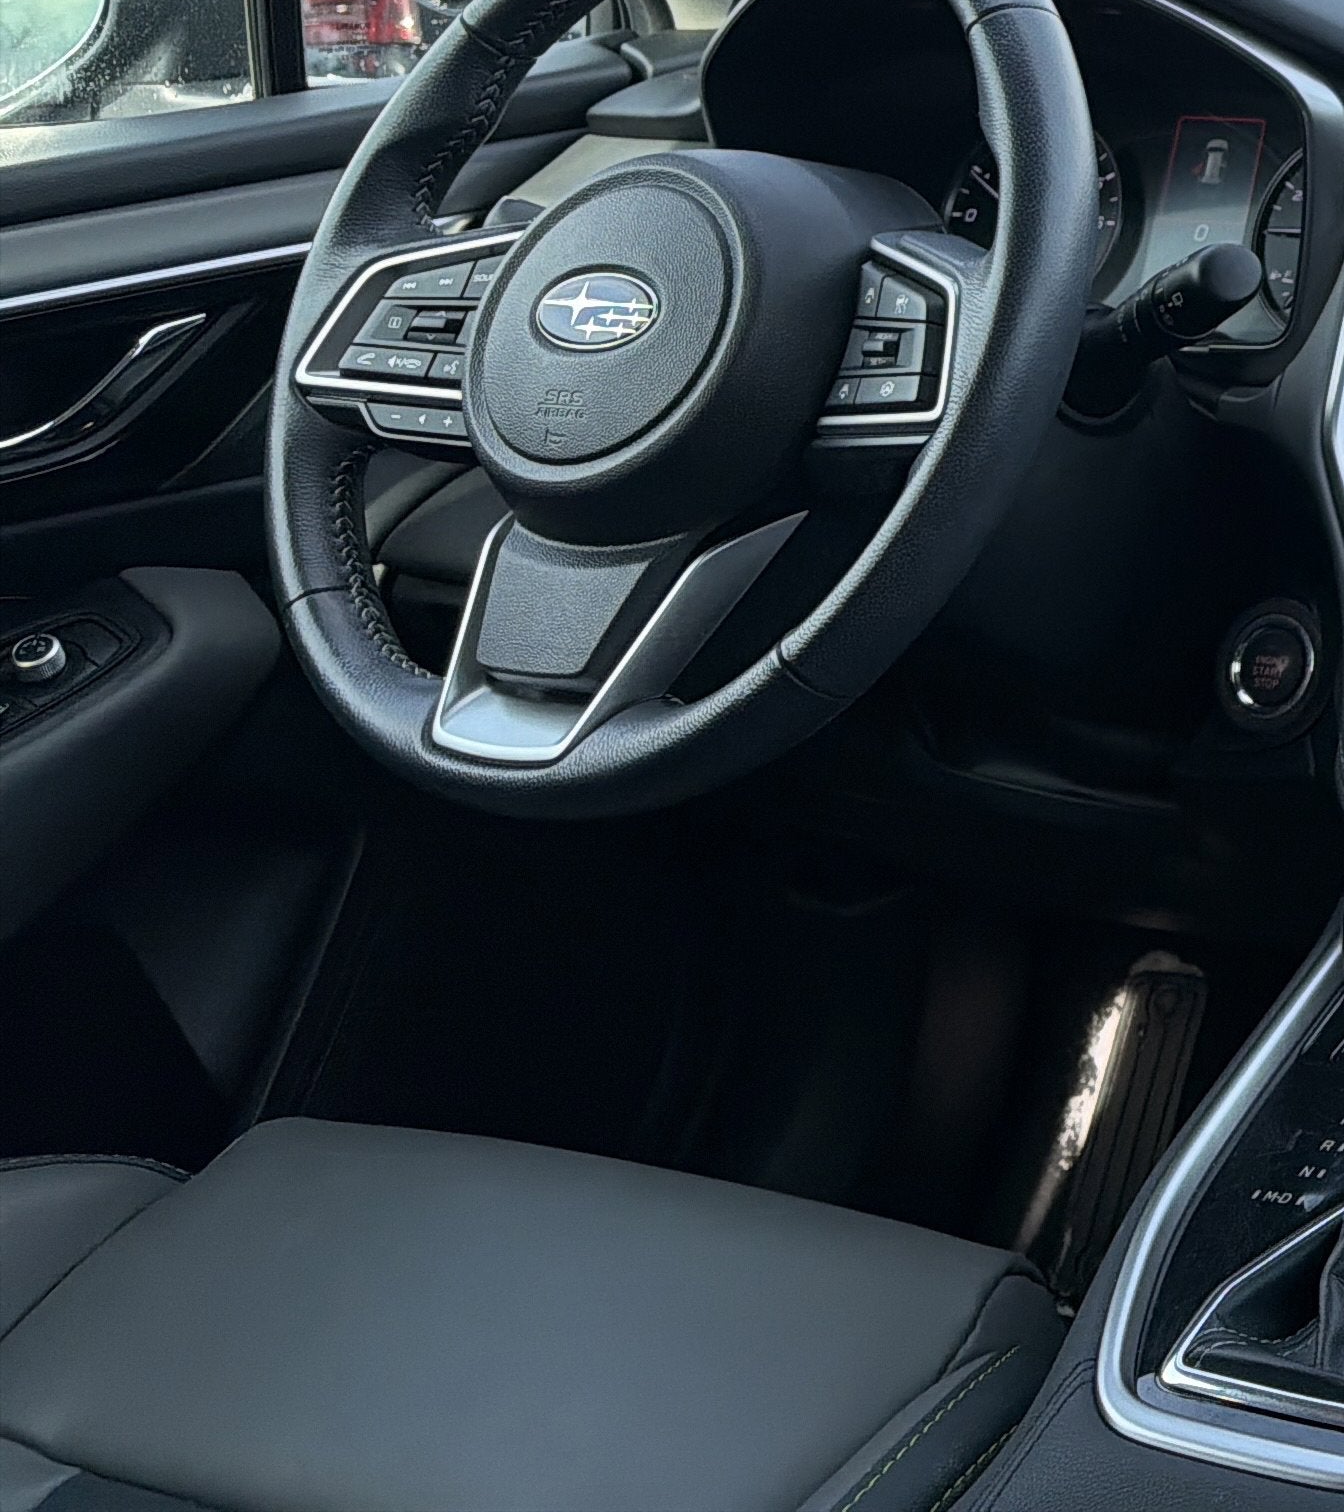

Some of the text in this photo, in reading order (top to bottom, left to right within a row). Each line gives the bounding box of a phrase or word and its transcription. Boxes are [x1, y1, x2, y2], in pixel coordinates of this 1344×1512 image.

[1194, 224, 1209, 242] 0
[546, 390, 585, 406] SRS
[534, 407, 587, 420] AIRBAG
[1319, 1139, 1335, 1152] R
[1298, 1165, 1315, 1178] N
